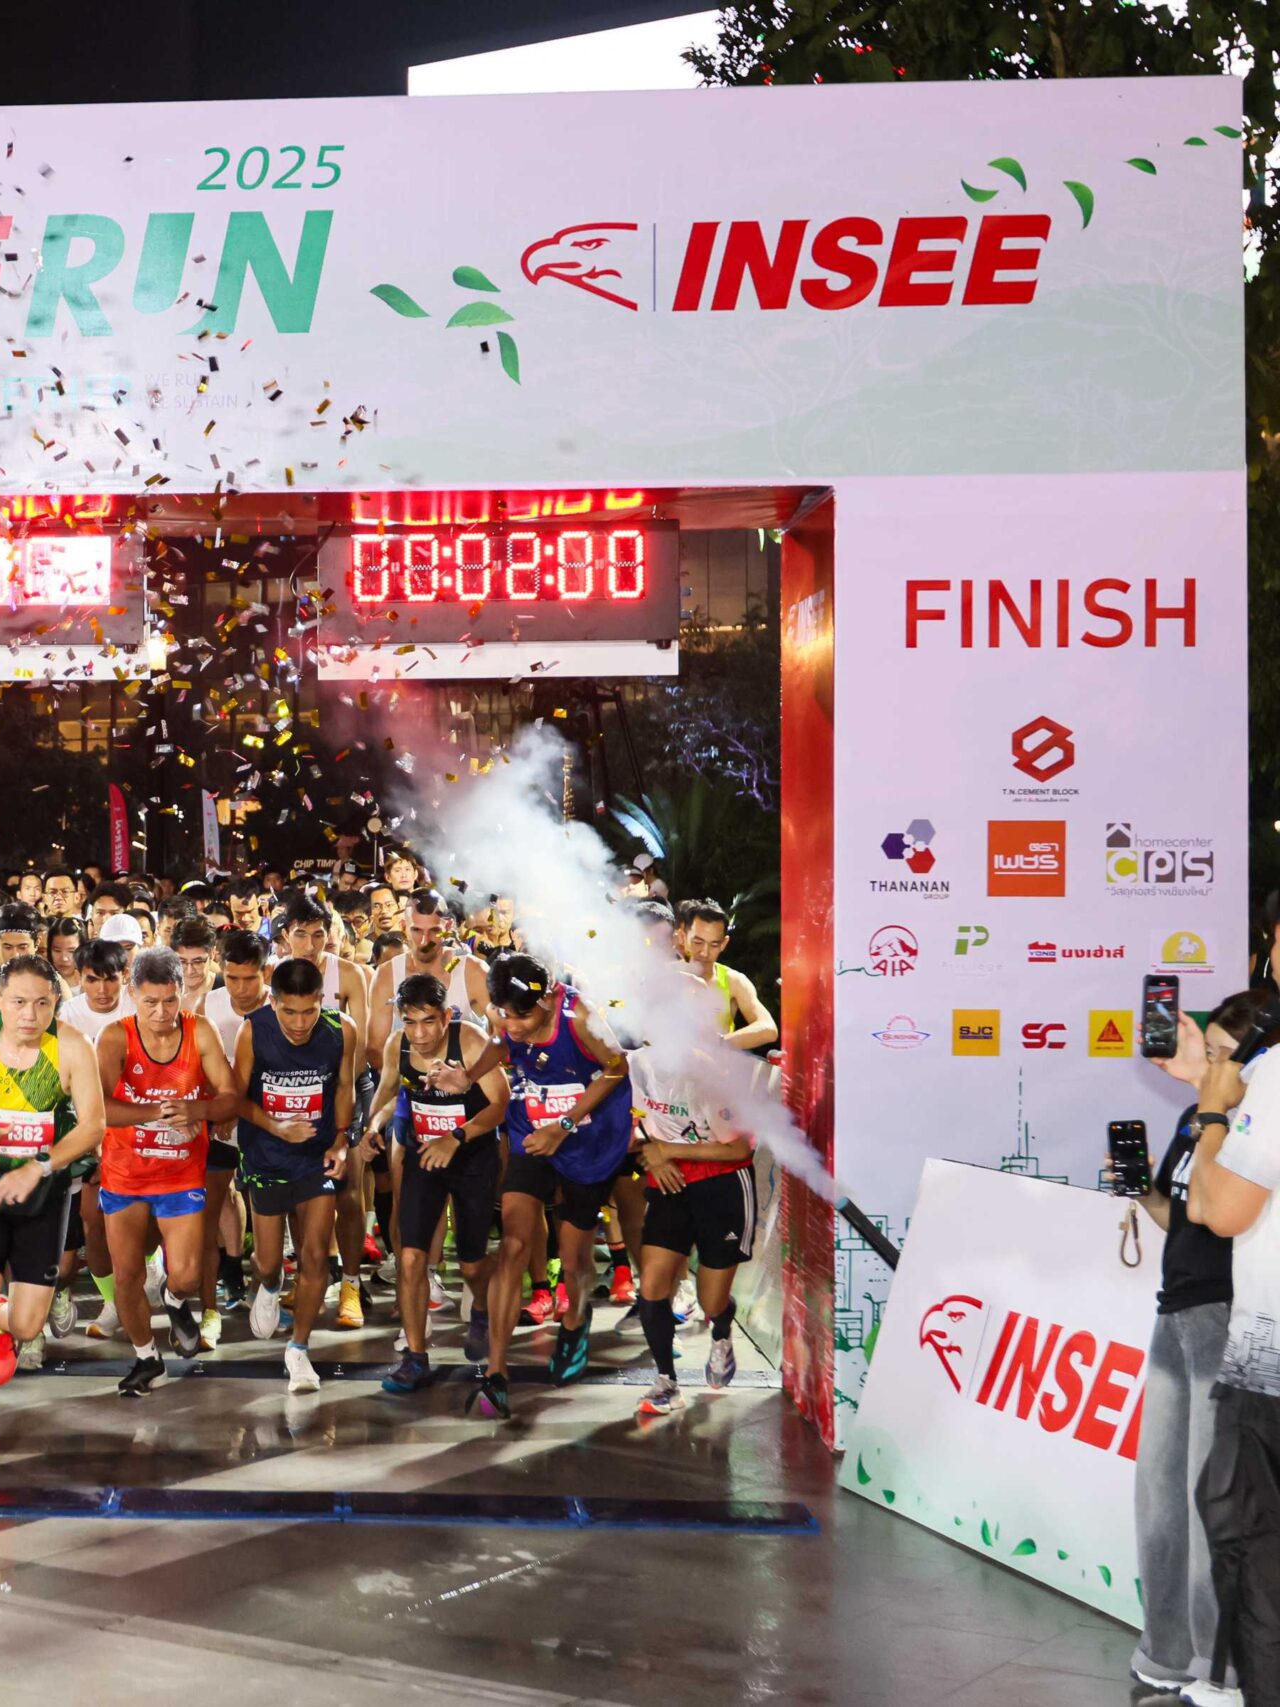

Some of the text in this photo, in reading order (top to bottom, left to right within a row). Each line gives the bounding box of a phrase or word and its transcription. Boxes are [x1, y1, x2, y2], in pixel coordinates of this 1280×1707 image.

[196, 145, 346, 191] 2025
[671, 214, 1052, 312] INSEE
[175, 373, 208, 387] RU
[351, 529, 644, 603] 00:02:00
[905, 577, 1197, 649] FINISH
[1051, 788, 1080, 796] BLOCK
[1134, 833, 1213, 848] homecenter
[294, 859, 315, 869] CHIP
[1105, 850, 1214, 884] CPS
[869, 880, 950, 892] THANANAN
[872, 958, 915, 977] AIA
[959, 1025, 994, 1035] SJC
[1021, 1023, 1067, 1049] SC
[284, 1096, 311, 1109] 537
[426, 1116, 457, 1131] 1365
[153, 1131, 173, 1145] 45
